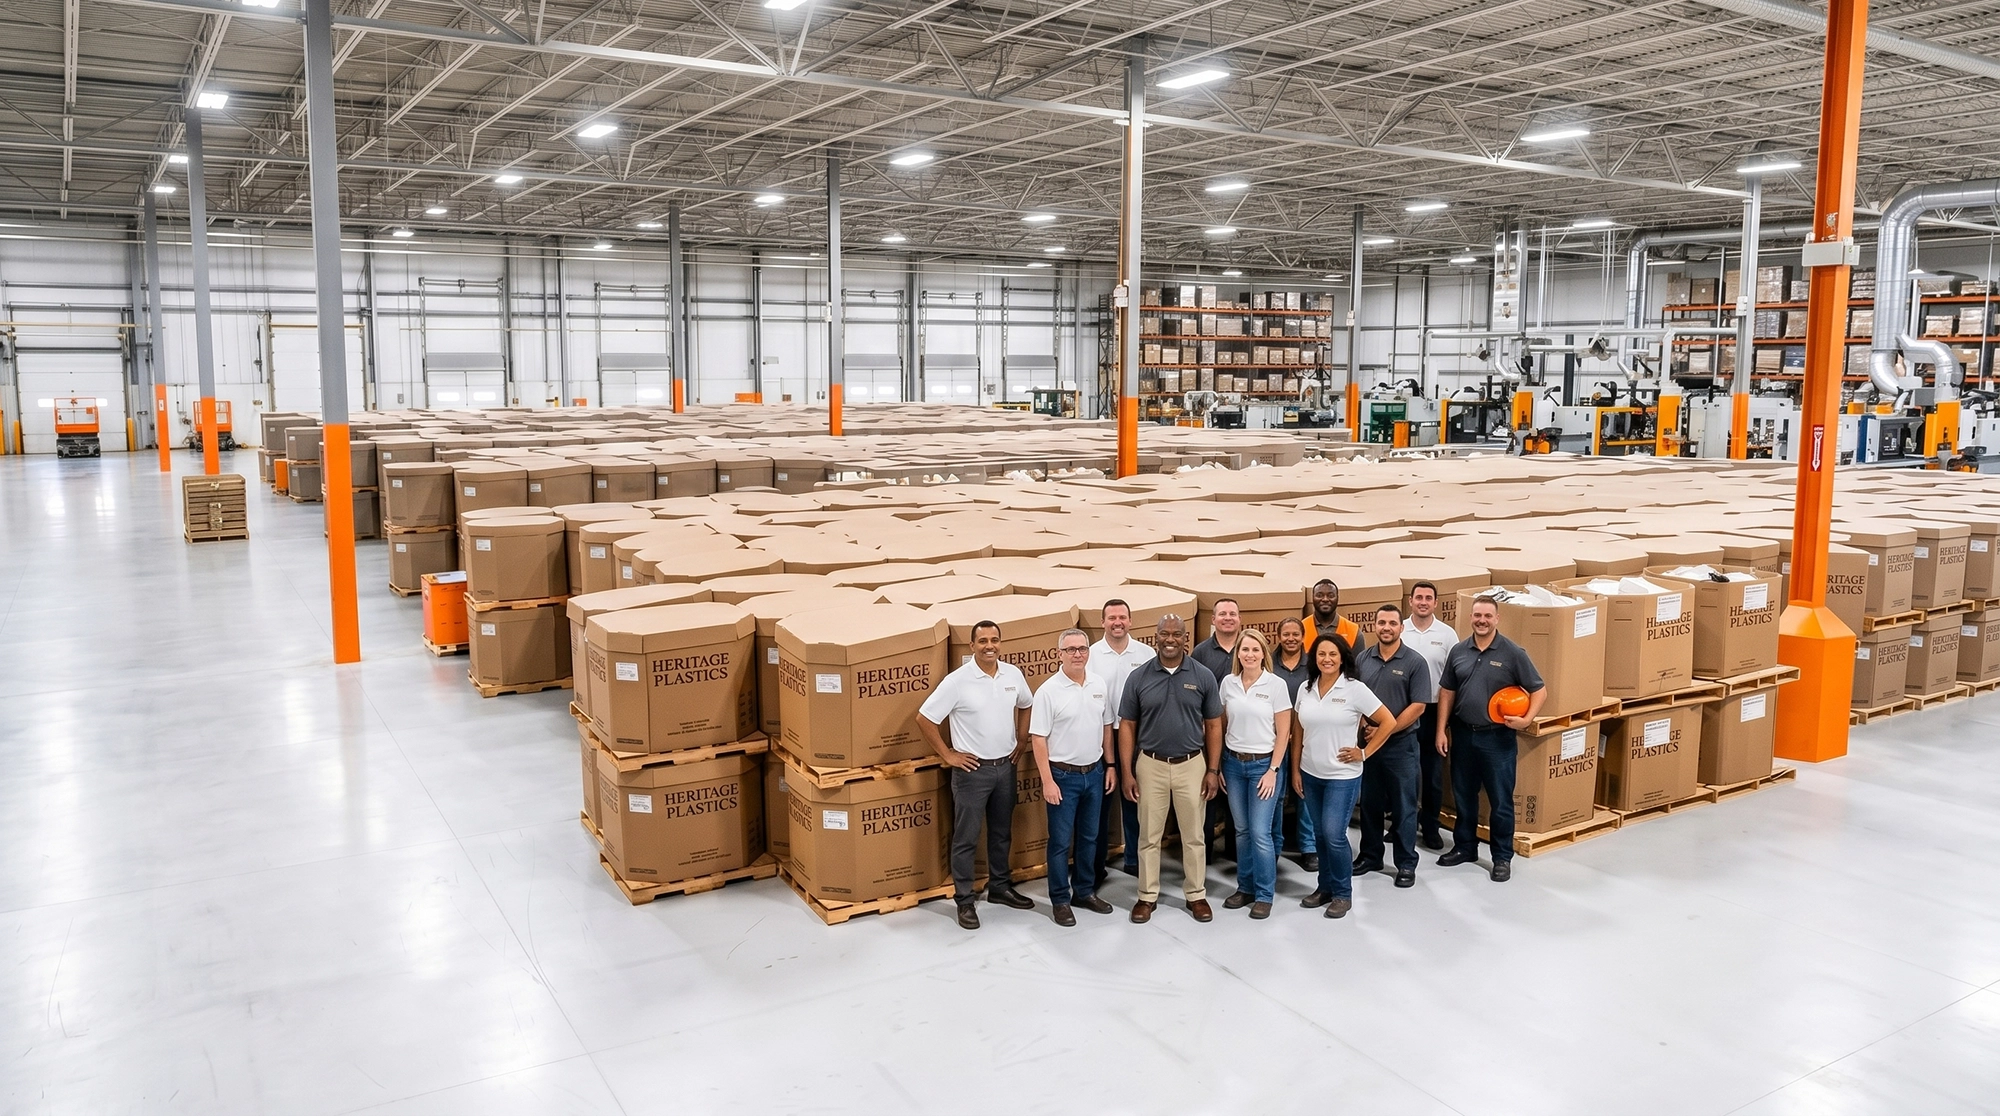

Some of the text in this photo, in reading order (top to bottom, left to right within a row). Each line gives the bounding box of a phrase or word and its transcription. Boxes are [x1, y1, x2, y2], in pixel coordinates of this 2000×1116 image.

[1828, 574, 1865, 585] RITAGE
[1826, 585, 1863, 595] ASTICS
[1730, 612, 1772, 628] PLASTICS
[1647, 623, 1691, 641] PLASTICS
[652, 653, 730, 673] HERITAGE
[998, 648, 1060, 665] HERITAG
[654, 667, 728, 687] PLASTICS
[856, 663, 930, 684] HERITAGE
[858, 677, 930, 699] PLASTICS
[1631, 741, 1679, 760] PLASTICS
[1549, 758, 1594, 779] PLASTICS
[664, 782, 739, 806] HERITAGE
[666, 797, 738, 819] PLASTICS
[861, 799, 933, 822] HERITAGE
[862, 813, 931, 836] PLASTICS
